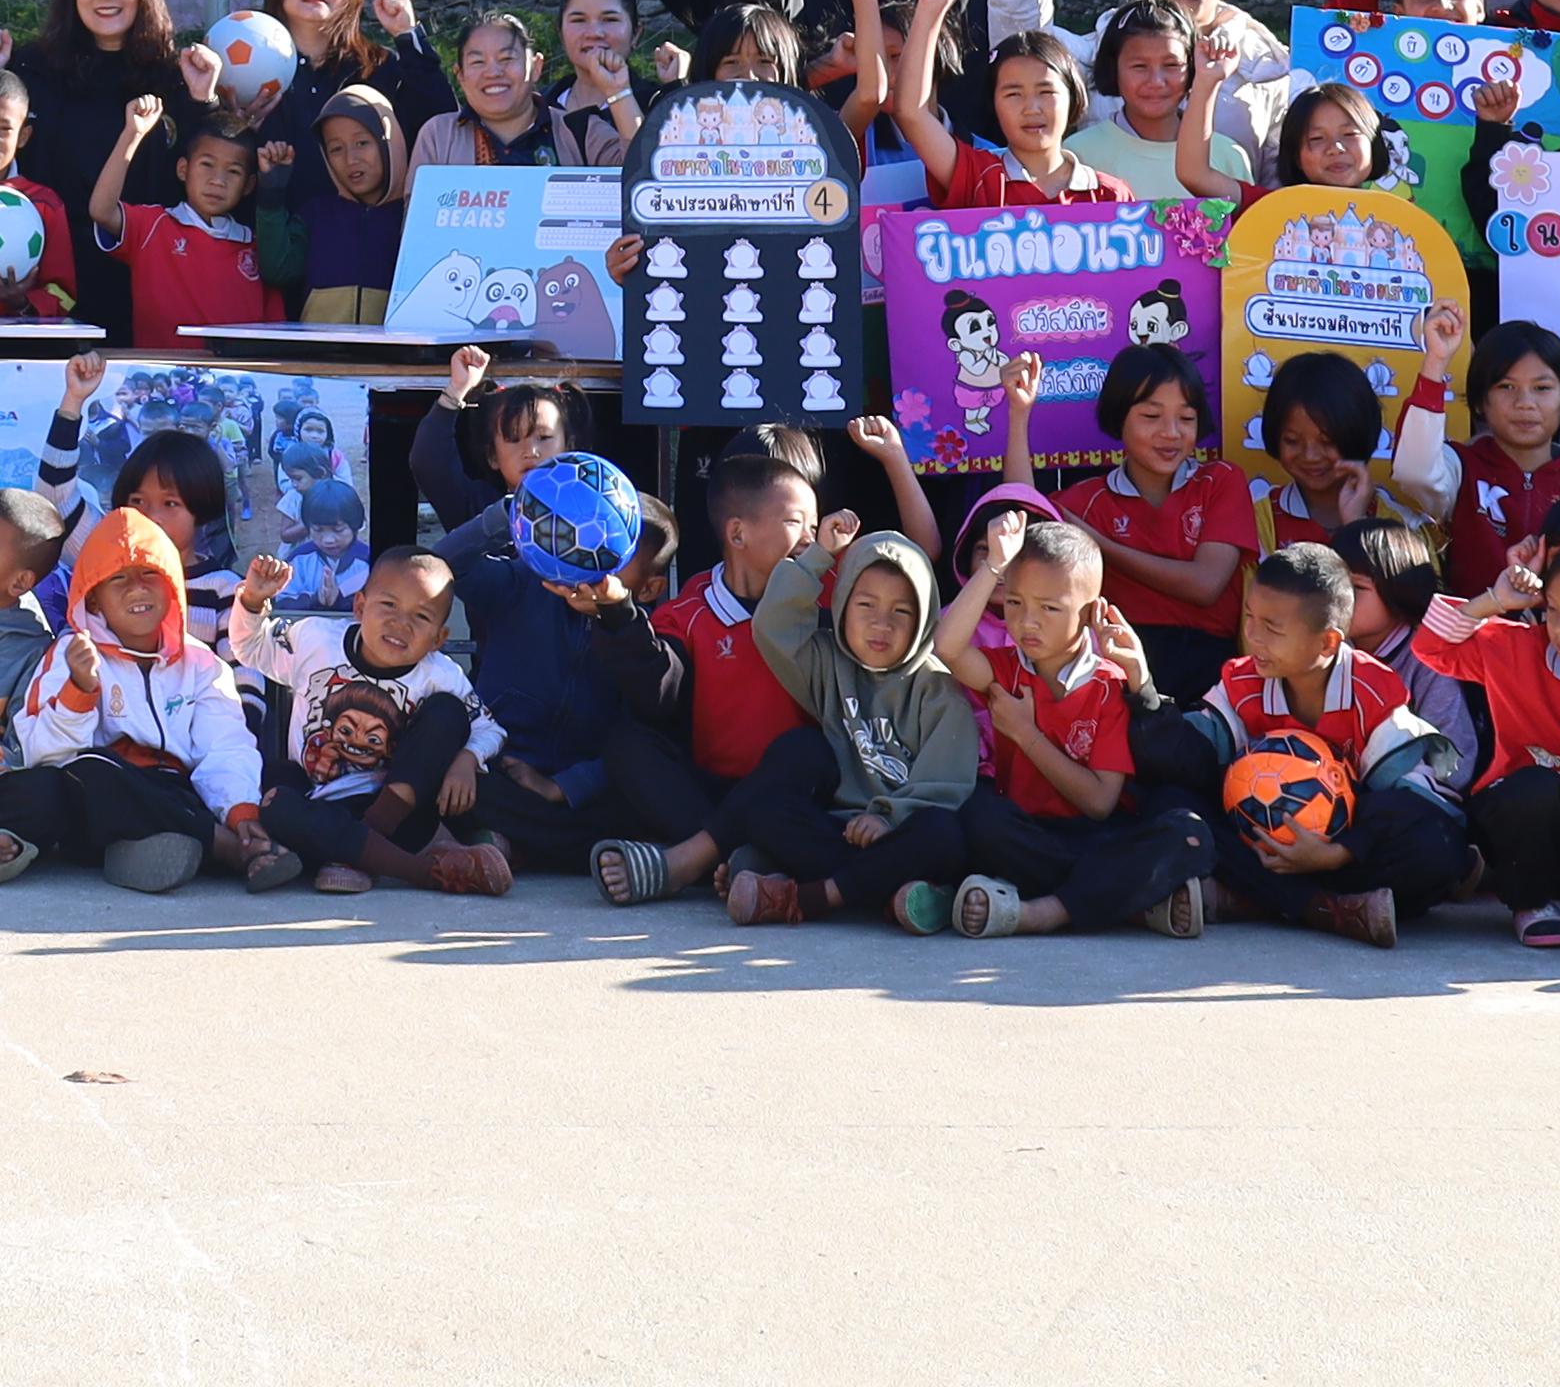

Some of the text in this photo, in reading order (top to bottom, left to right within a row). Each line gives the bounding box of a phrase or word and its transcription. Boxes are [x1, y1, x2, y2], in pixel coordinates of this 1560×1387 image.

[659, 149, 823, 177] สมาชิกในห้องเรียน
[456, 189, 511, 209] BARE
[649, 186, 834, 216] ชั้นประถมศึกษาปีที่ 4
[435, 209, 507, 228] BEARS
[916, 202, 1163, 282] ยินดีต้อนรับ
[1273, 268, 1429, 304] สมาชิกในห้องเรียน
[1017, 300, 1108, 334] สวัสดีค่ะ
[1262, 301, 1403, 338] ชั้นประถมศึกษาปีที่
[1476, 479, 1511, 524] K
